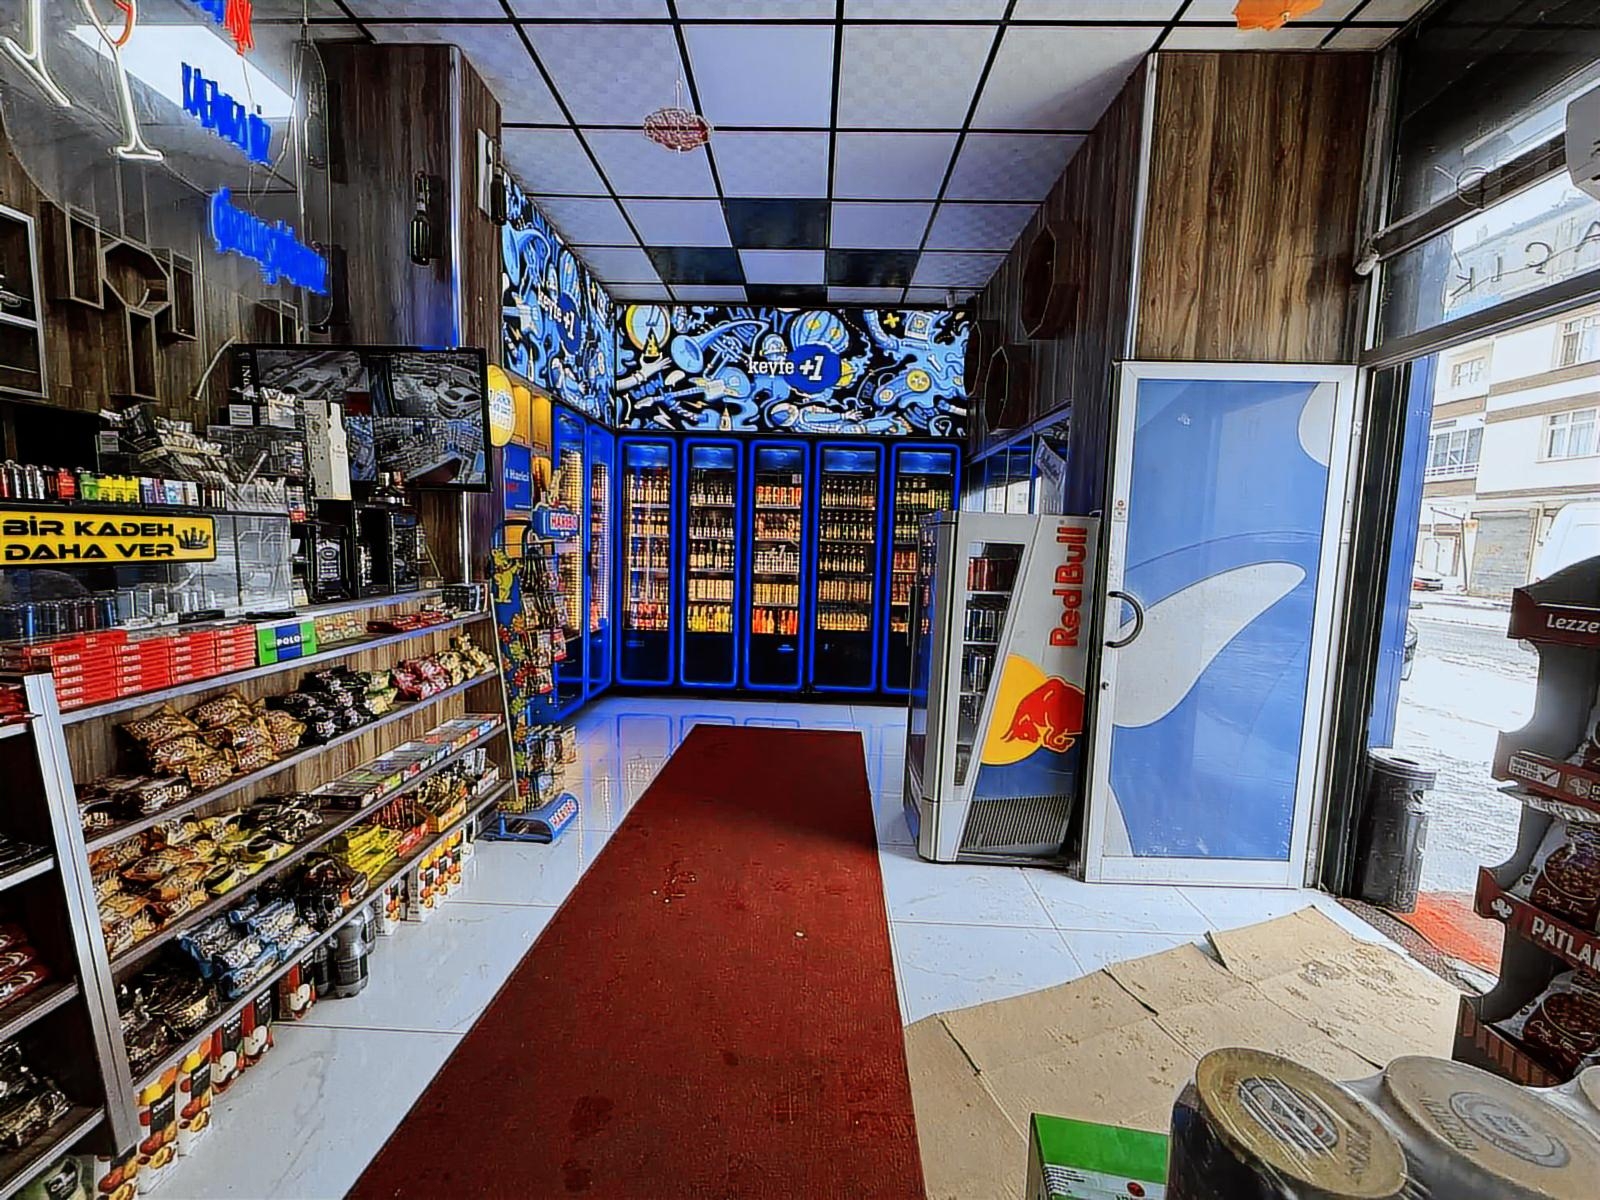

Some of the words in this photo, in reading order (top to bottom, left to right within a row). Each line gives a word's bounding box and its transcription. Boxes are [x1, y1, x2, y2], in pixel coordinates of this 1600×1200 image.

[800, 355, 824, 381] +1
[3, 515, 64, 536] BİR
[74, 520, 174, 537] KADEH
[5, 543, 107, 561] DAHA
[115, 542, 175, 558] VER
[1054, 526, 1088, 585] Bull
[1049, 588, 1081, 647] Red
[276, 635, 300, 646] POLO
